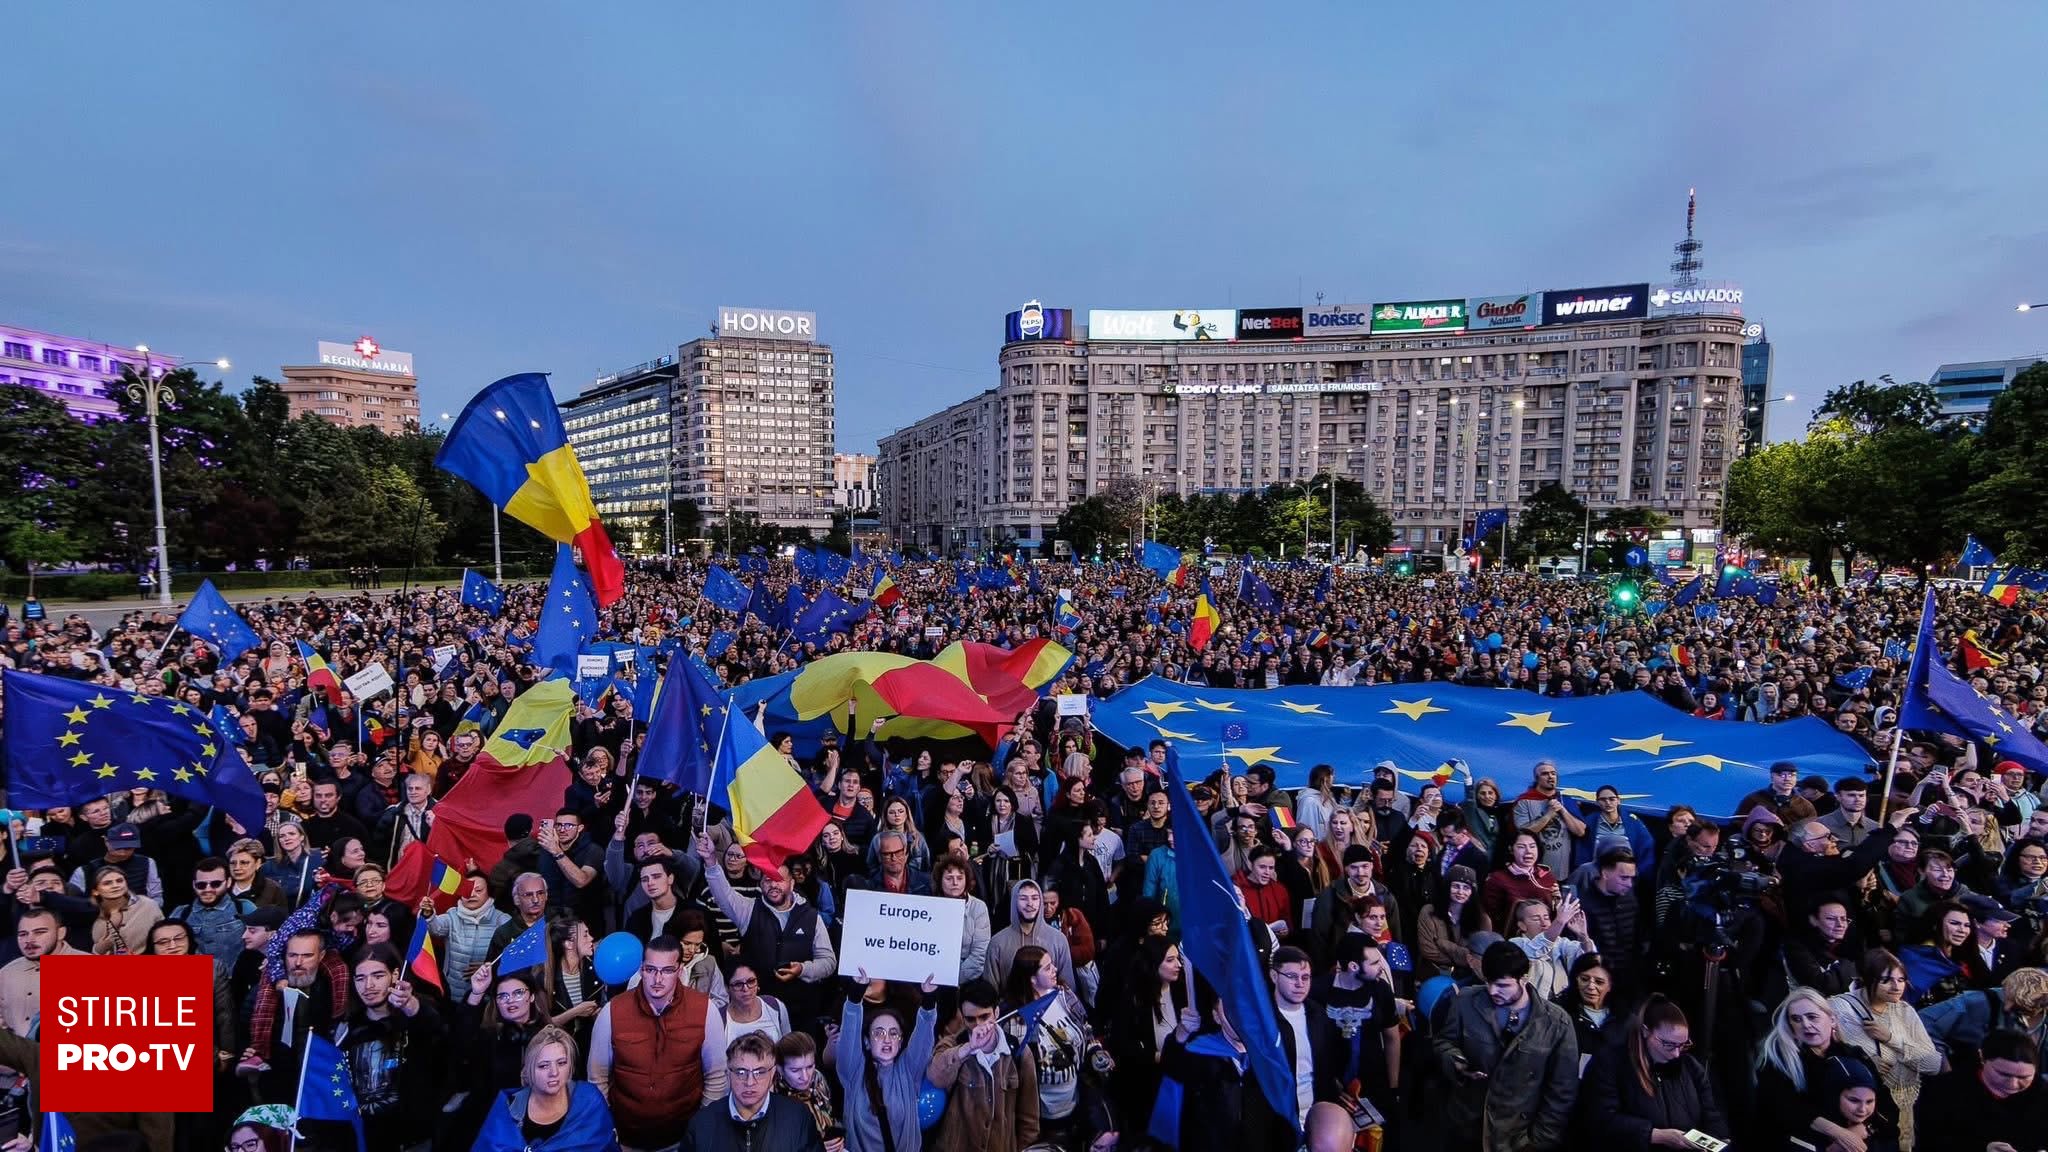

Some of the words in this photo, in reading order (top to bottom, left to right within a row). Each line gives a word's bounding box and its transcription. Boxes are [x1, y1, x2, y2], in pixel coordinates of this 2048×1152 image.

[1671, 289, 1744, 304] SANADOR
[1403, 305, 1461, 320] ALBACHR
[1477, 301, 1527, 319] Giusto
[1556, 295, 1633, 316] winner
[722, 312, 811, 335] HONOR
[1103, 315, 1153, 335] Wolt
[1242, 316, 1299, 330] NetBet
[1309, 313, 1365, 327] BORSEC
[1488, 316, 1522, 327] Natura
[322, 353, 371, 371] REGINA
[372, 360, 411, 376] MARIA
[1219, 384, 1262, 394] CLINIC
[1271, 383, 1319, 393] SANATATEA
[1327, 382, 1378, 392] FRUMUSETE
[878, 902, 933, 922] Europe,
[864, 938, 886, 949] we
[888, 936, 941, 956] belong.
